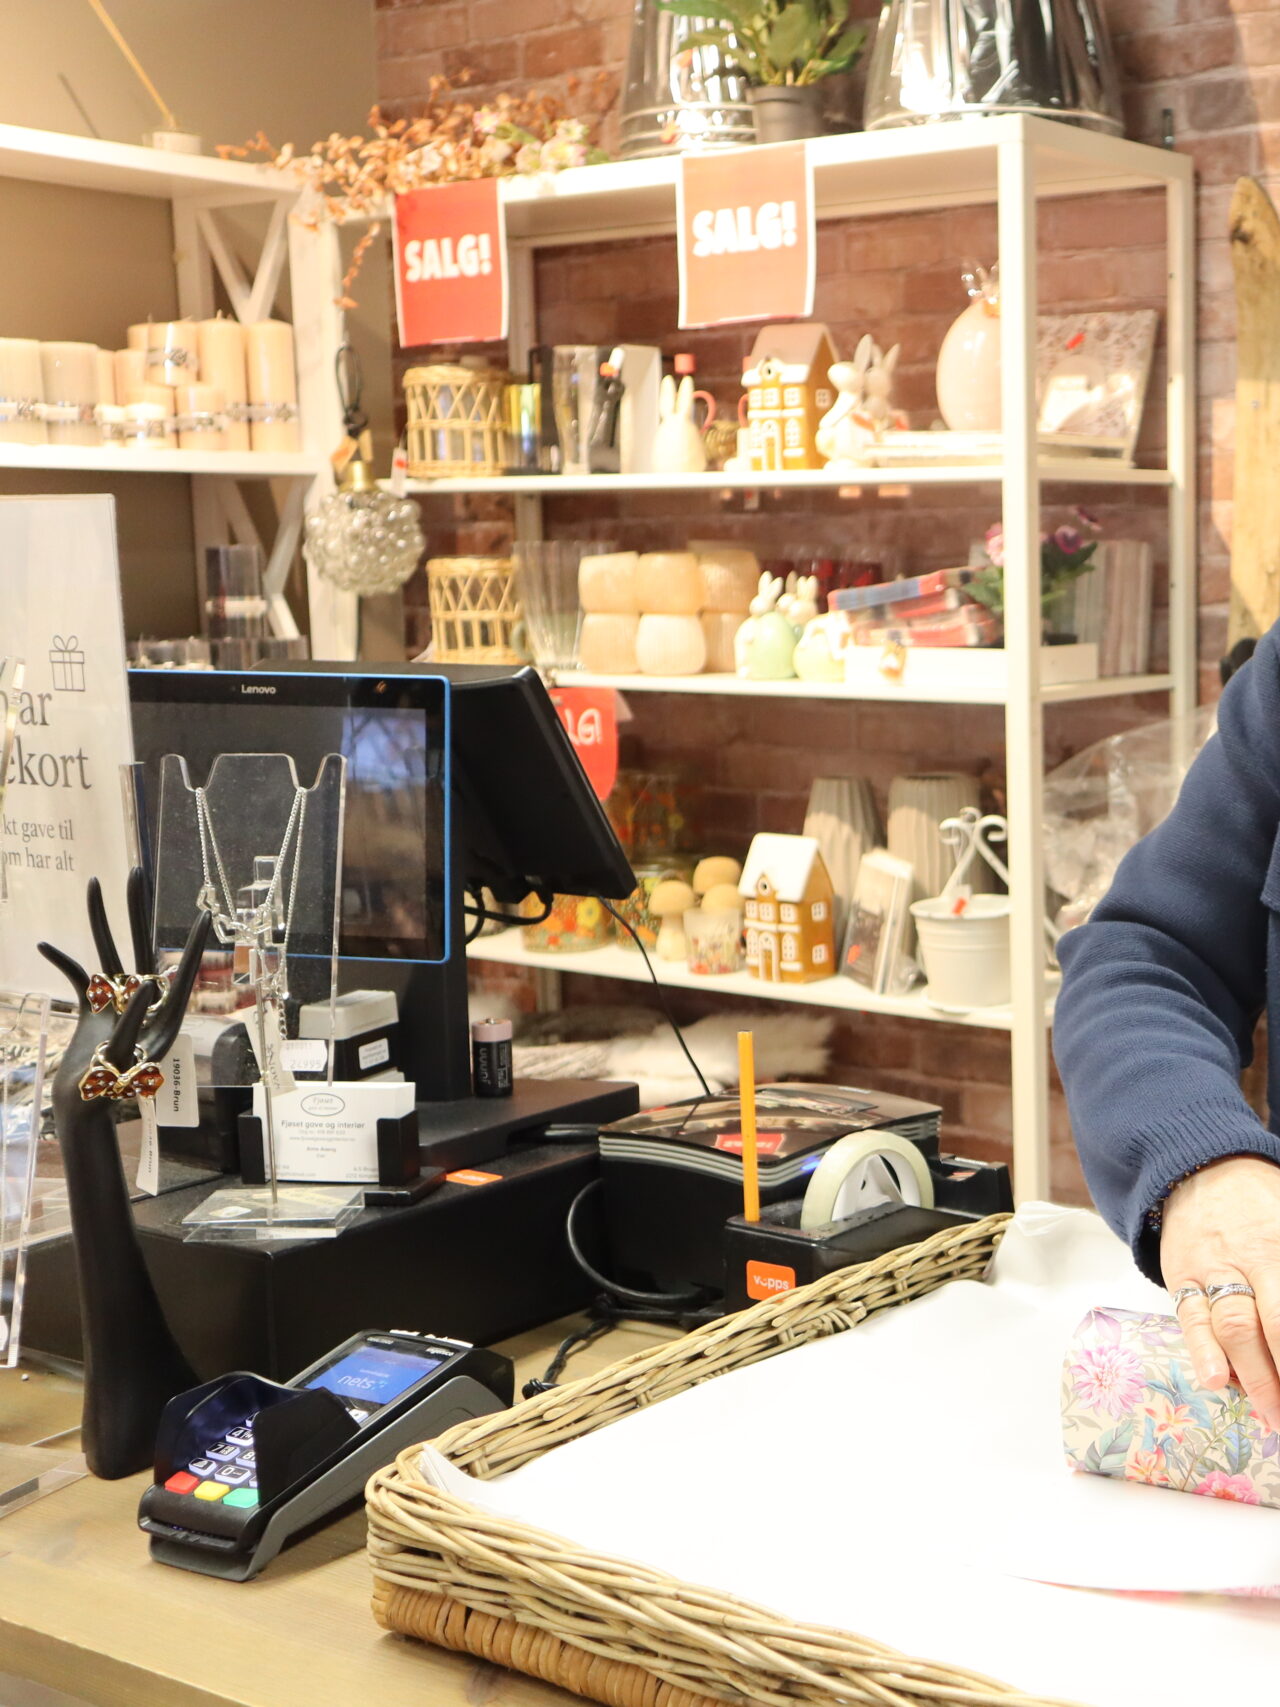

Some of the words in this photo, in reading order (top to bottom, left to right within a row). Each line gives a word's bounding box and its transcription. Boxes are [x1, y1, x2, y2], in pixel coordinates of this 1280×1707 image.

[692, 200, 797, 257] SALG!
[405, 233, 492, 283] SALG!
[241, 684, 277, 694] Lenovo
[21, 822, 55, 843] gave
[58, 818, 74, 841] til
[25, 847, 51, 869] har
[55, 850, 75, 872] alt
[325, 1122, 336, 1130] og
[337, 1374, 375, 1390] nets
